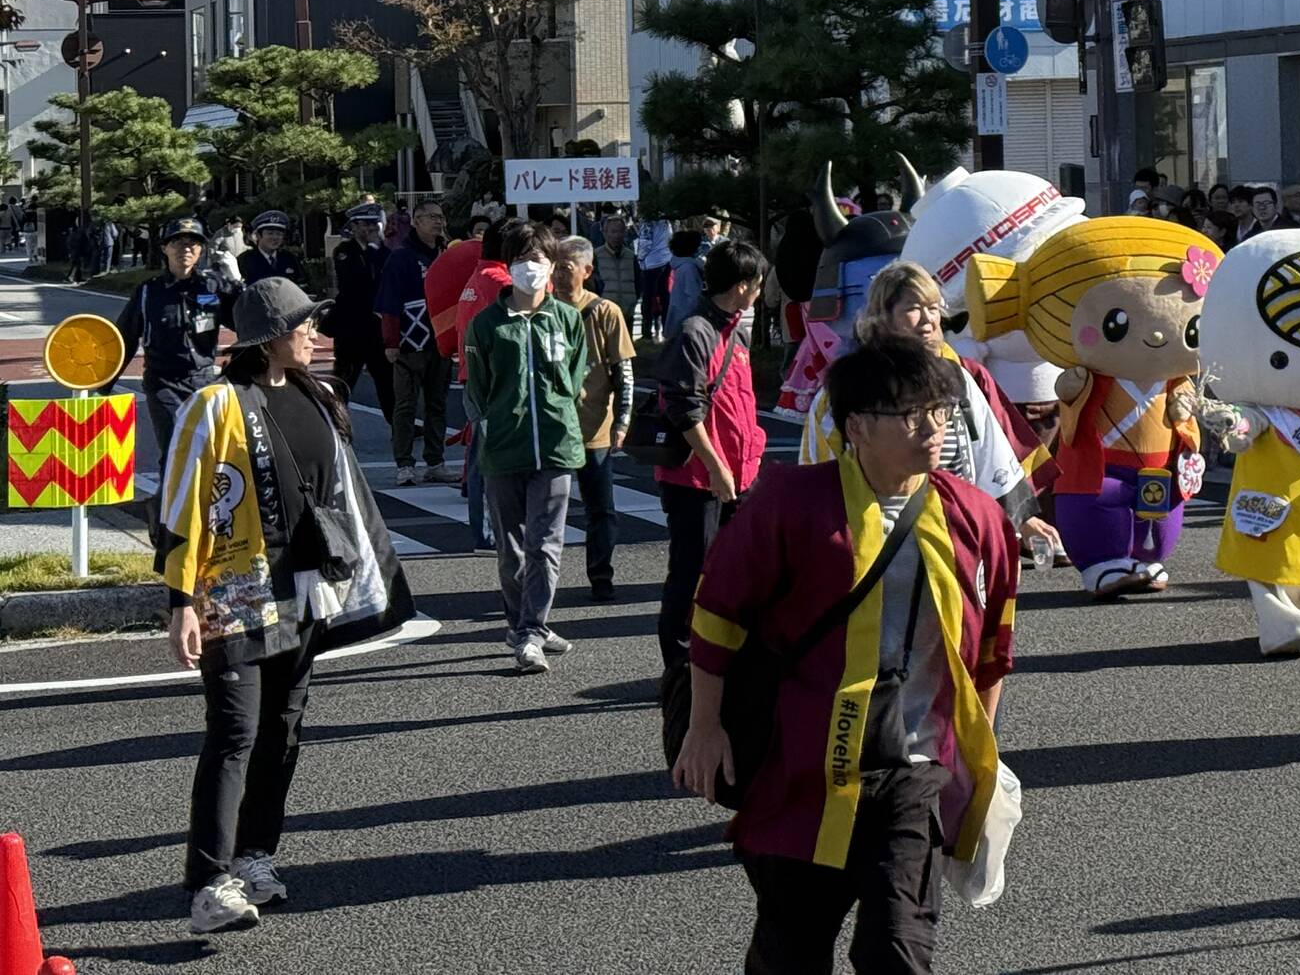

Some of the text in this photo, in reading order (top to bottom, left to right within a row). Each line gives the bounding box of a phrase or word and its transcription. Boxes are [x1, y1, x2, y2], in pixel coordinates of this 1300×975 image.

[513, 167, 632, 191] パレード最後尾
